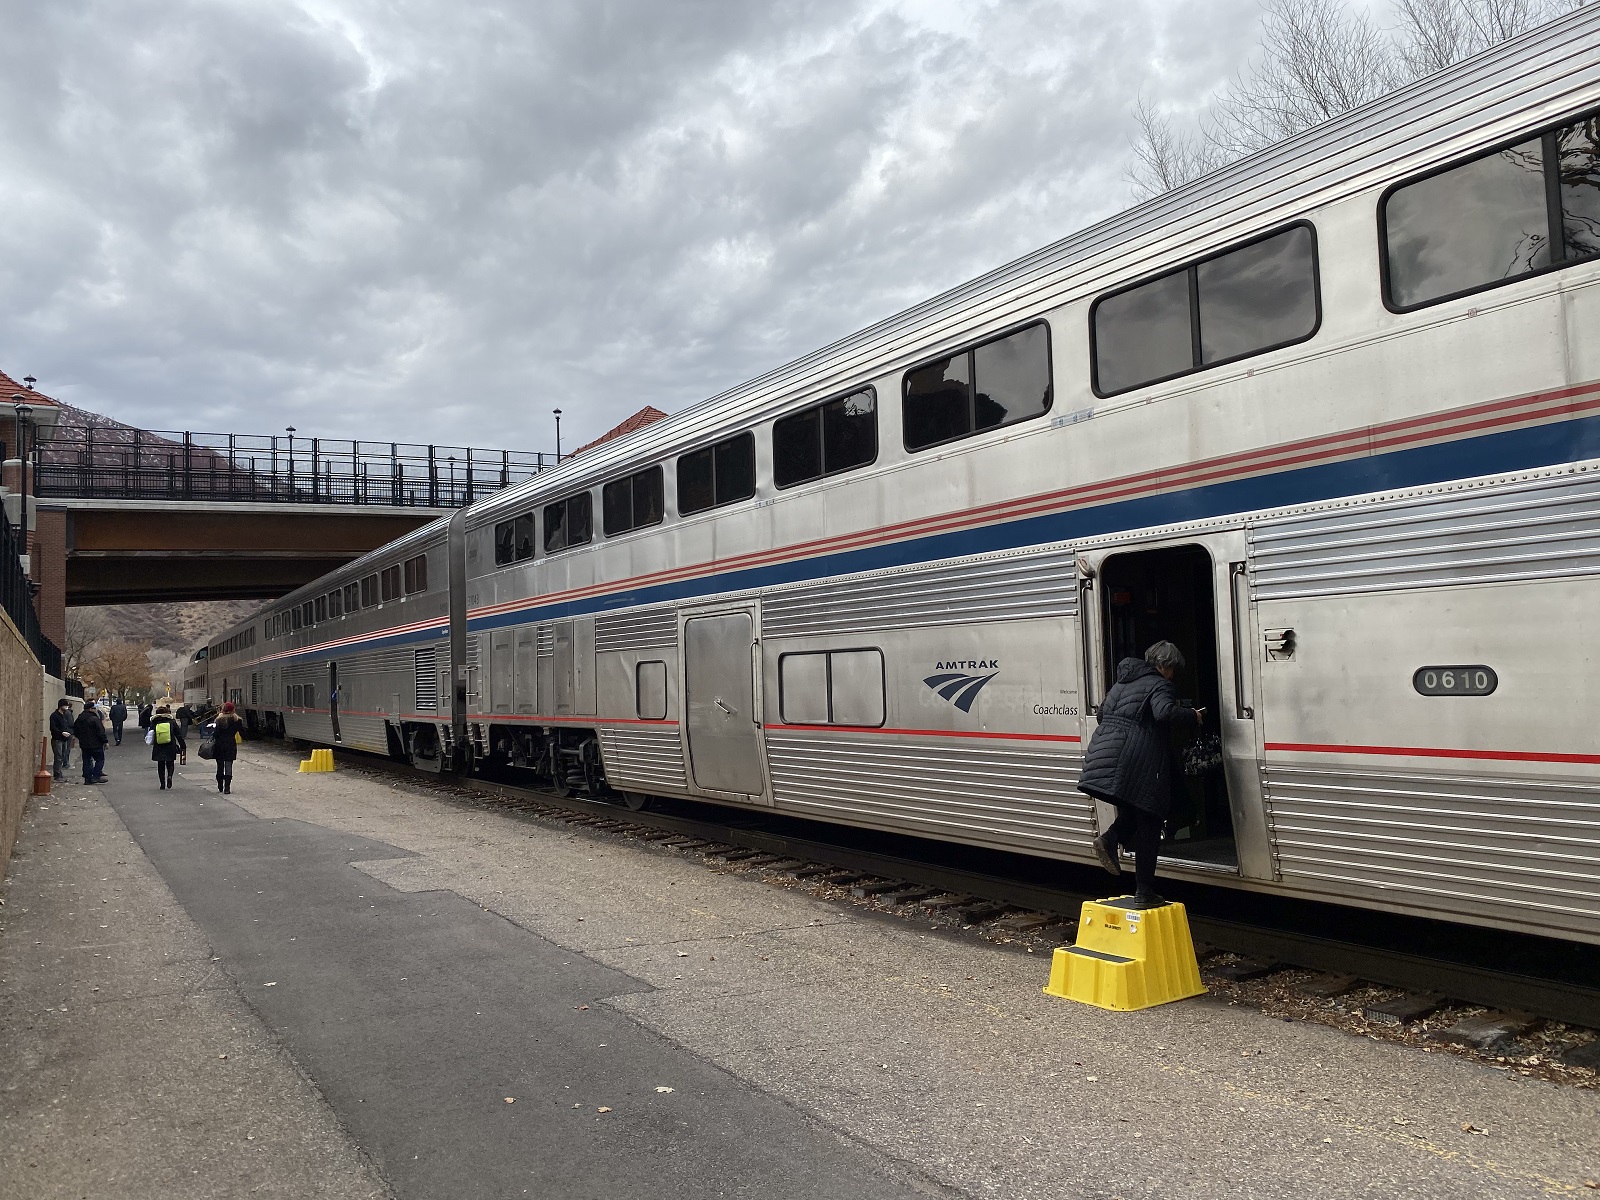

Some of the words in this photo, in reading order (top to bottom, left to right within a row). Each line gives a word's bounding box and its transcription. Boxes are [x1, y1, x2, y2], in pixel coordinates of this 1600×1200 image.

[935, 659, 999, 670] AMTRAK
[1424, 671, 1488, 689] 0610
[1033, 704, 1078, 716] Coachclass
